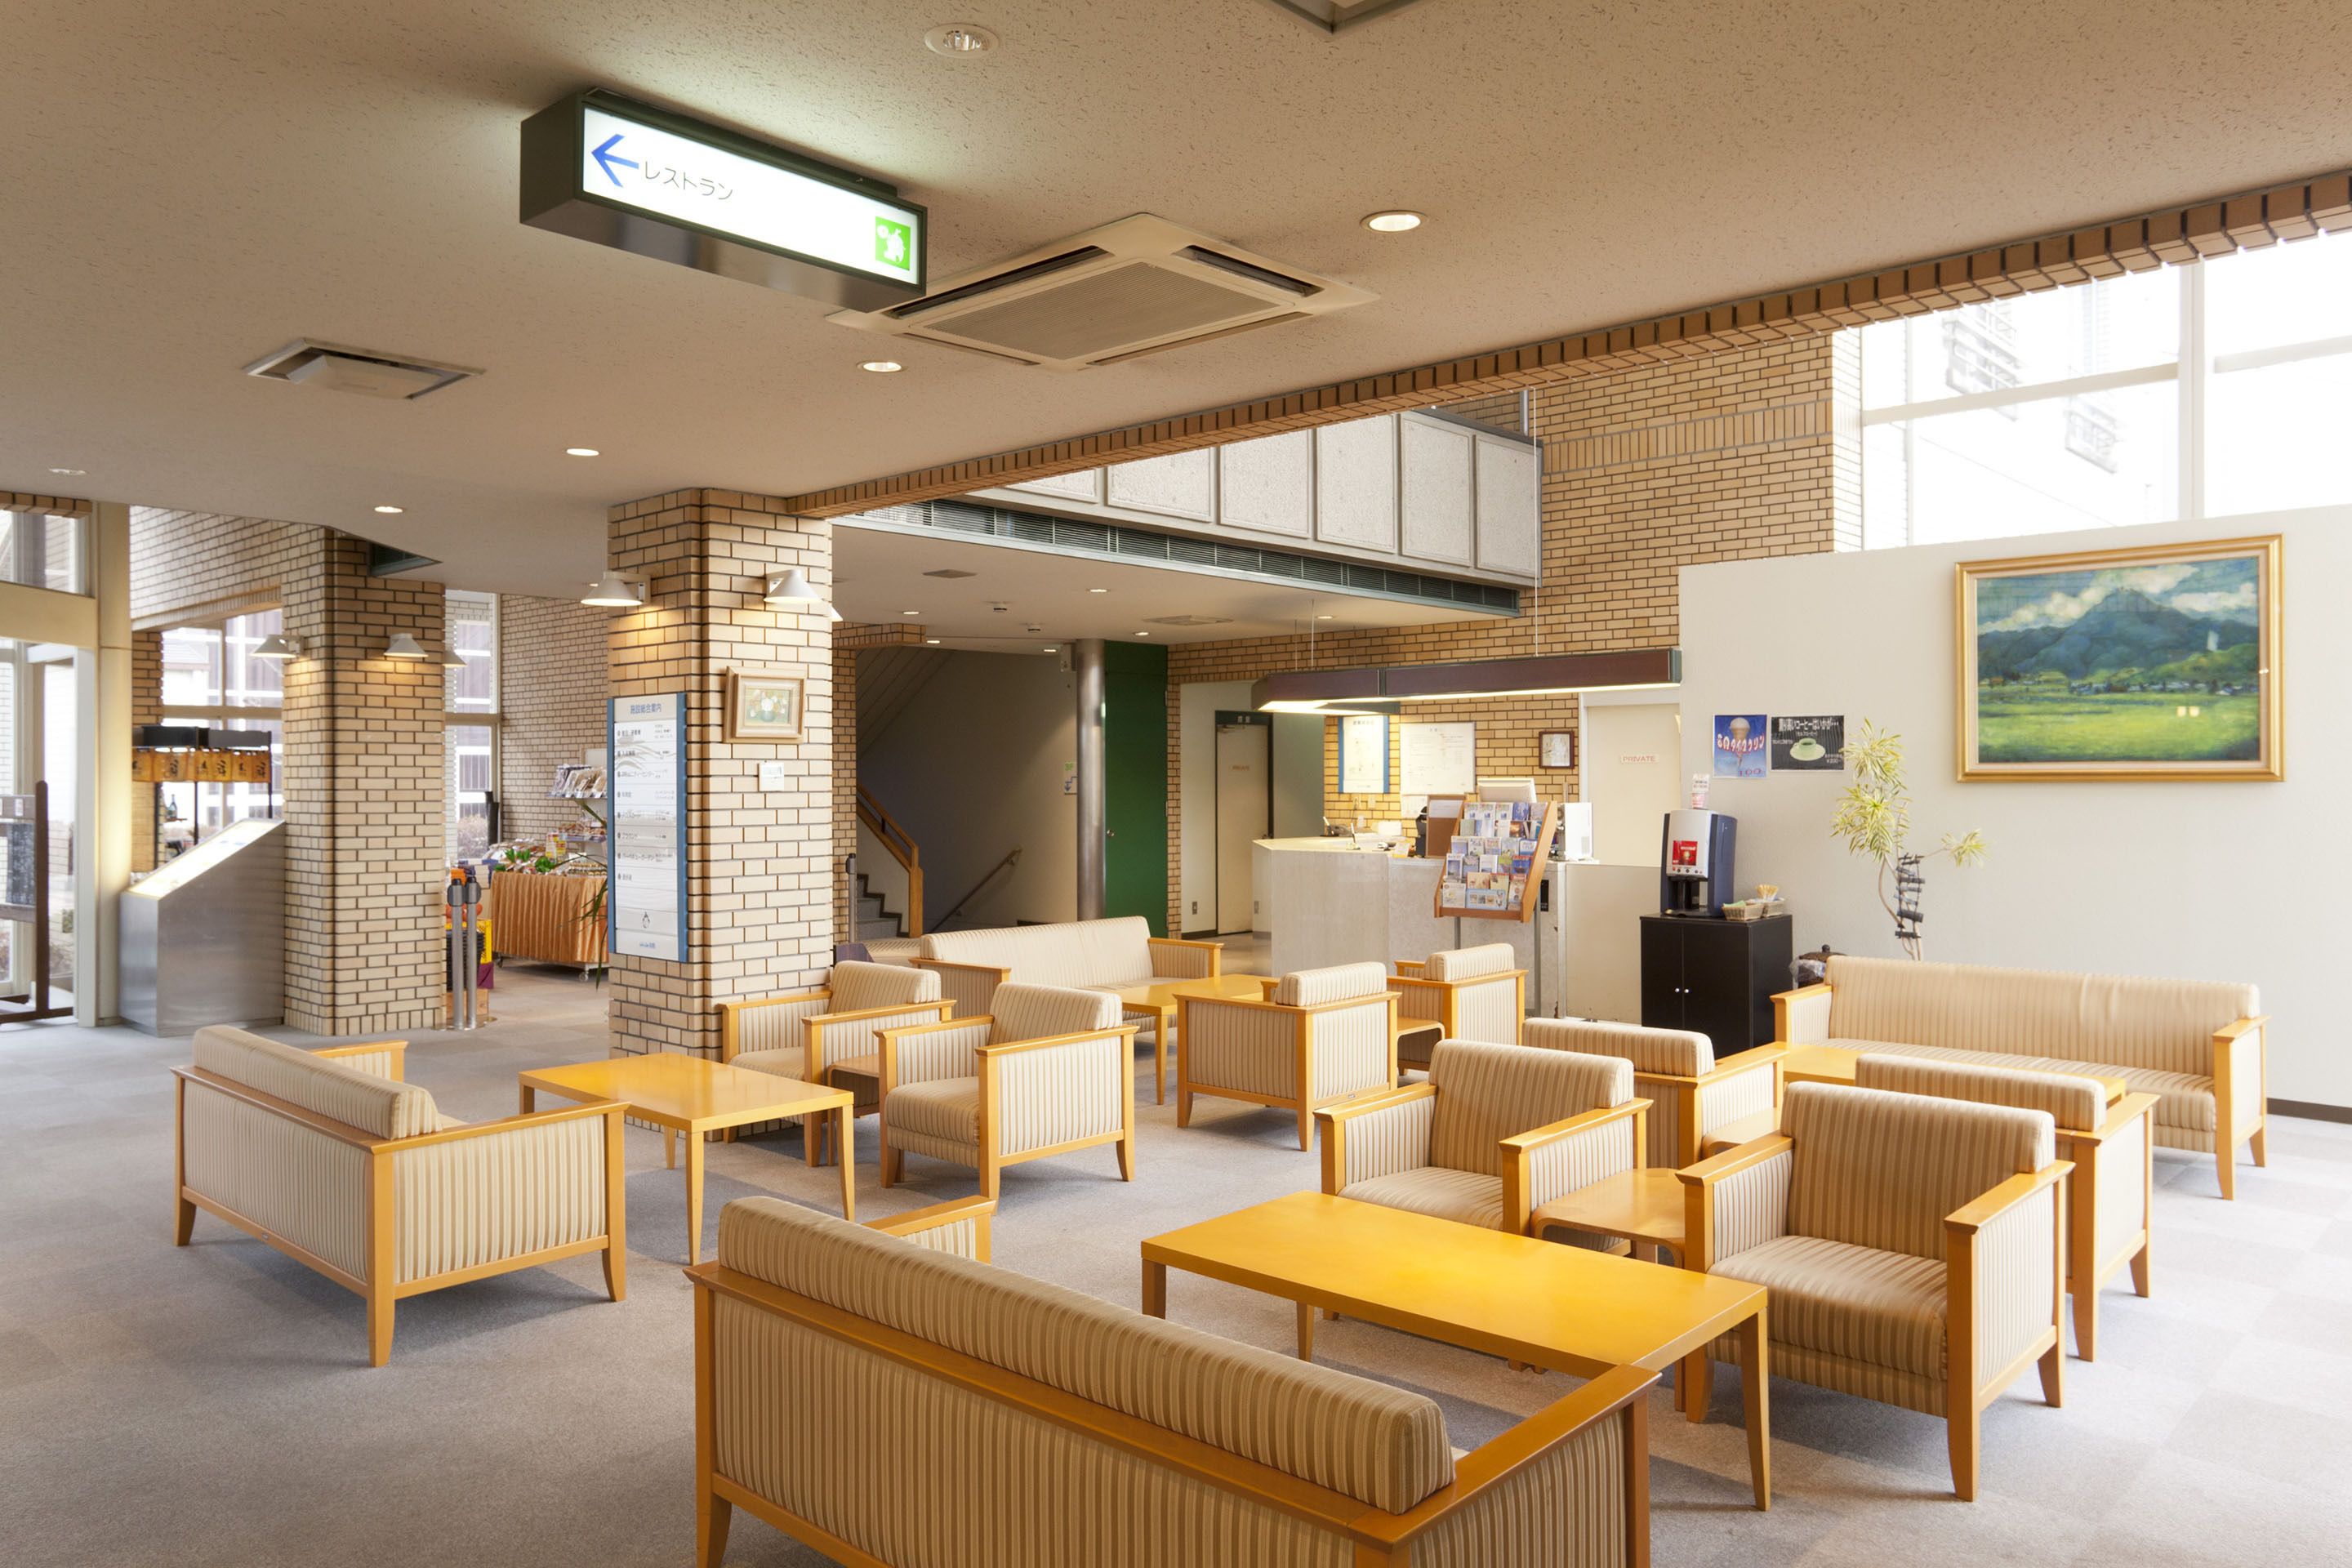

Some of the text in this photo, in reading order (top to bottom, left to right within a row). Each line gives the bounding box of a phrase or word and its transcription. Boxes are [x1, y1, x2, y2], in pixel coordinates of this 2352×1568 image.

[644, 160, 733, 200] レストラン
[1622, 755, 1657, 763] PRIVATE
